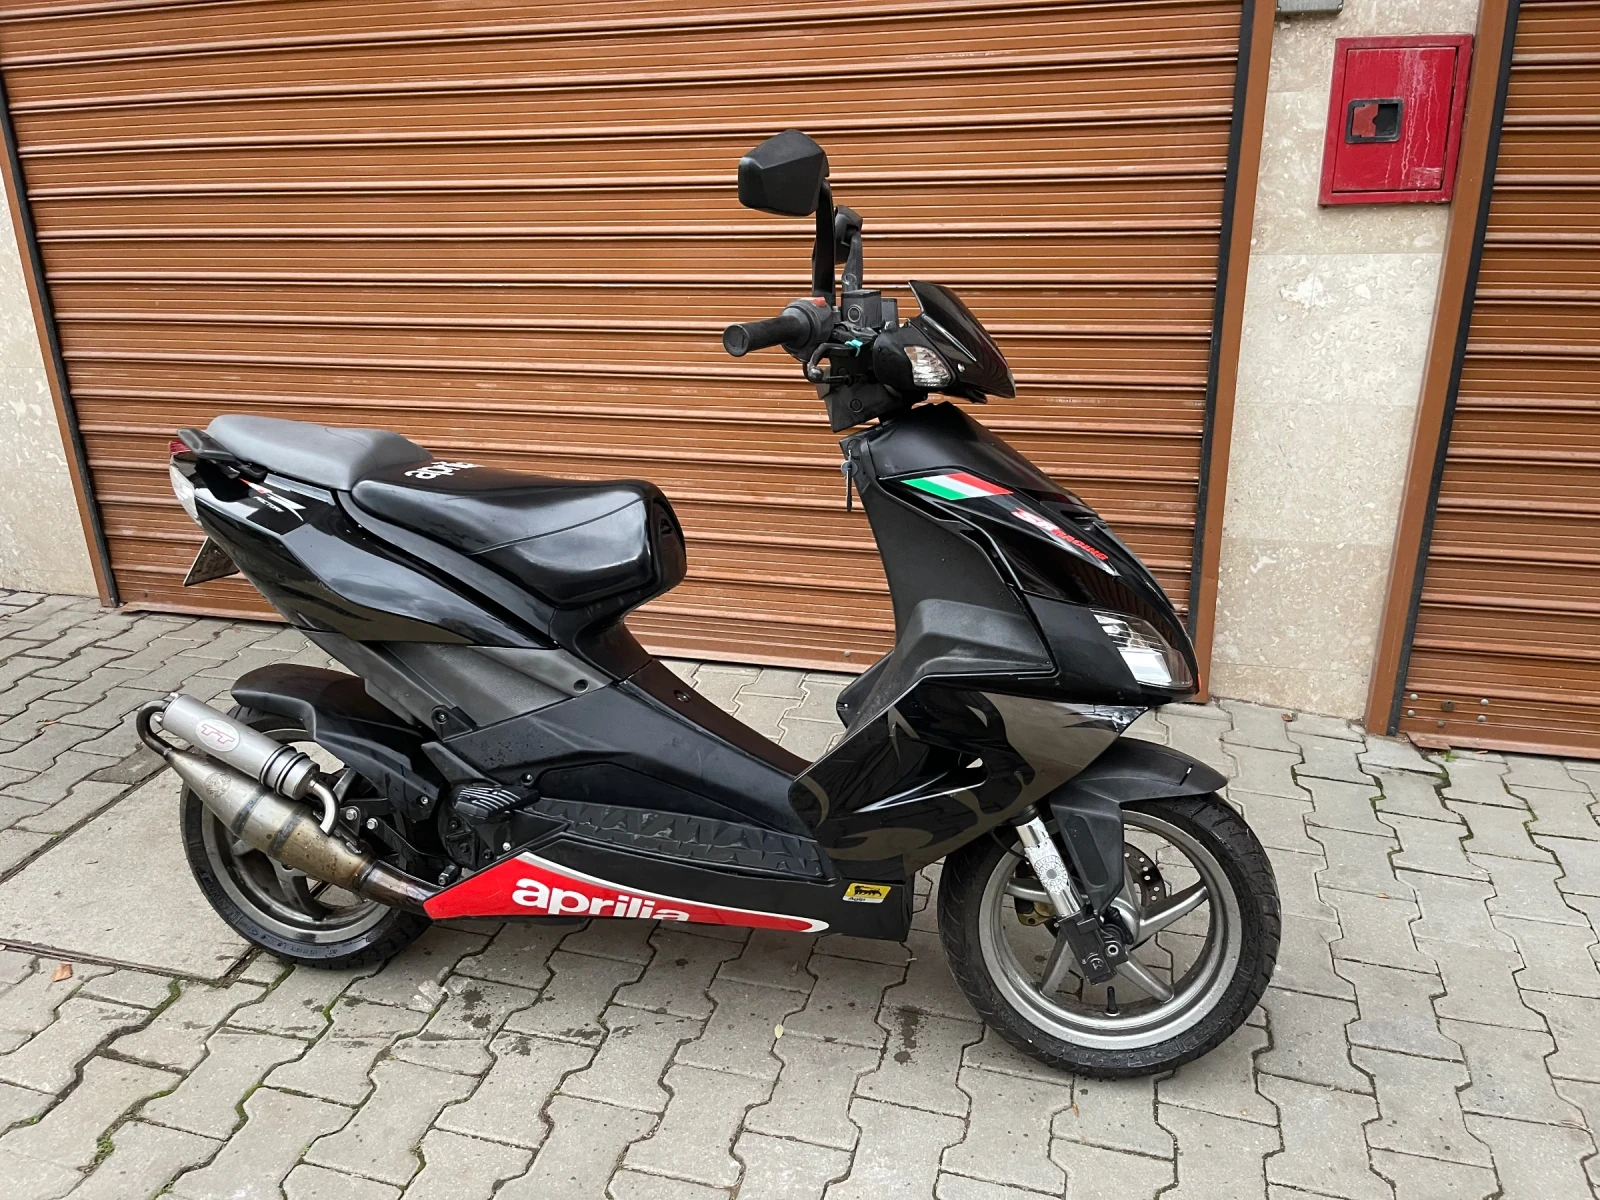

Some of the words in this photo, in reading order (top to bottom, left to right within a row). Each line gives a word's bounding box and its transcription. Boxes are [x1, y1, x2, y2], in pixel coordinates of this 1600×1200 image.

[1051, 528, 1109, 561] RACING
[201, 723, 236, 744] TT
[512, 877, 691, 922] aprilia
